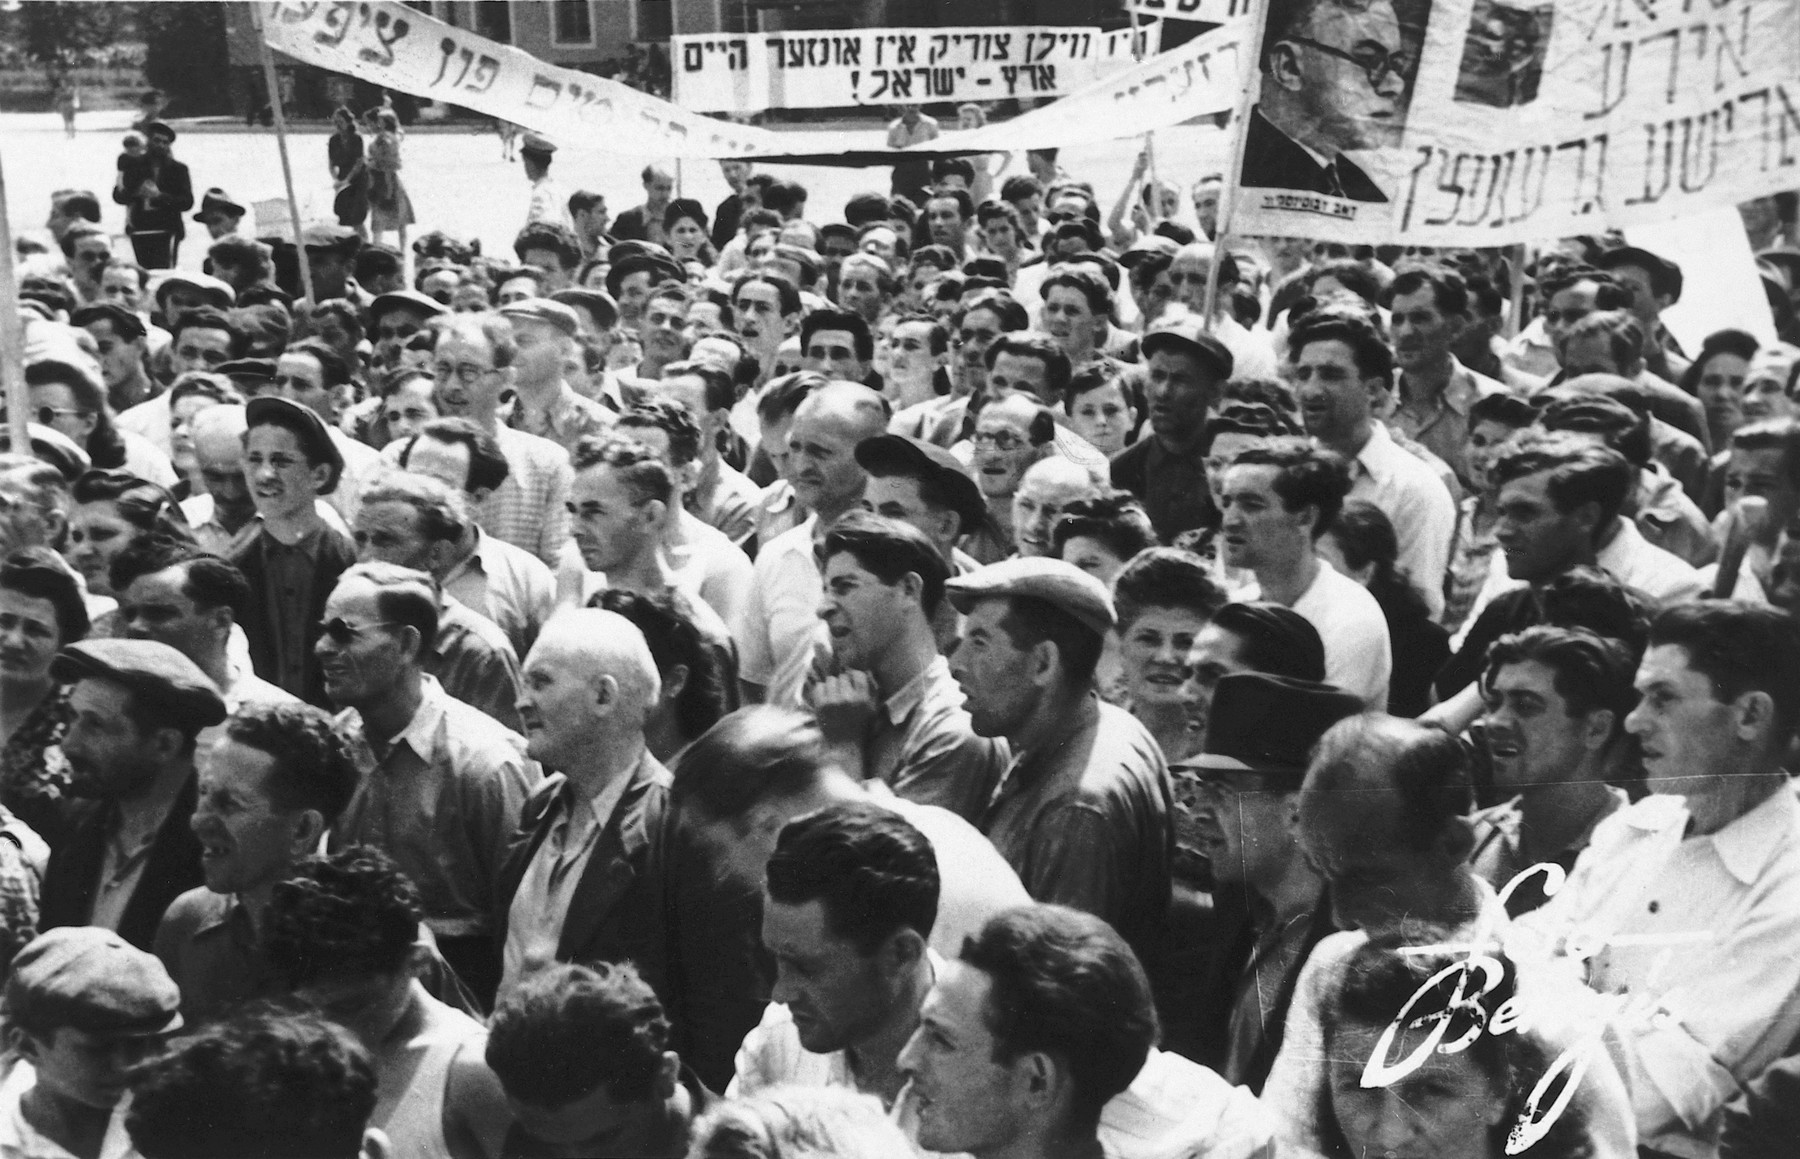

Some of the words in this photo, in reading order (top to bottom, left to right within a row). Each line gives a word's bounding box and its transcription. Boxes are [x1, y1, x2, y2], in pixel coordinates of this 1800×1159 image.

[684, 39, 748, 72] היים
[765, 36, 862, 70] אונזער
[875, 34, 918, 66] אין
[929, 32, 1013, 65] צוריק
[1023, 32, 1092, 65] ווילן
[428, 36, 503, 95] פון
[1000, 64, 1058, 95] ארץ
[1333, 203, 1358, 218] זאב
